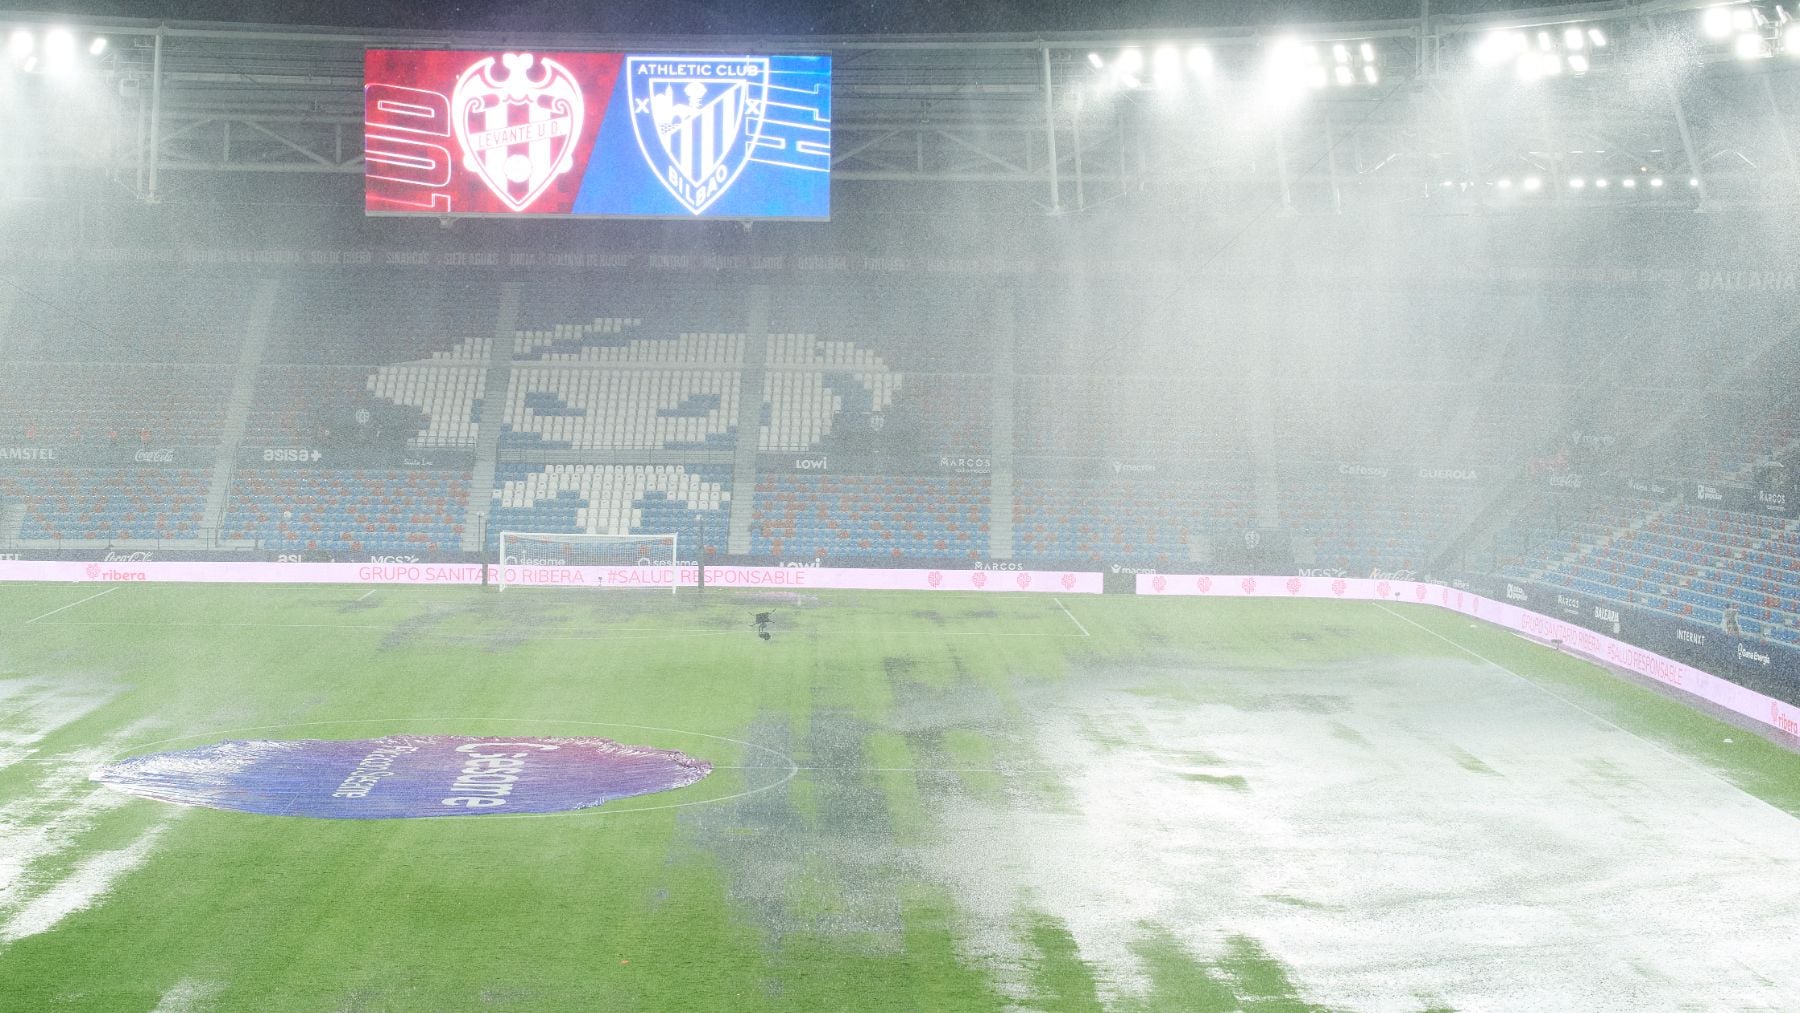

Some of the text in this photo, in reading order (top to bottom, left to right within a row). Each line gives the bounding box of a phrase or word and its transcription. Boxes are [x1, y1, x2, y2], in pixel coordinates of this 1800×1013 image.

[637, 64, 760, 77] ATHLETIC CLUB
[477, 126, 533, 148] LEVANTE
[668, 164, 728, 207] BILBAO
[940, 456, 991, 468] MARCOS
[975, 561, 1024, 571] MARCOS
[102, 569, 146, 581] ribera
[359, 566, 805, 585] GRUPO SANITARO RIBERA #SALUD RESPONSABLE
